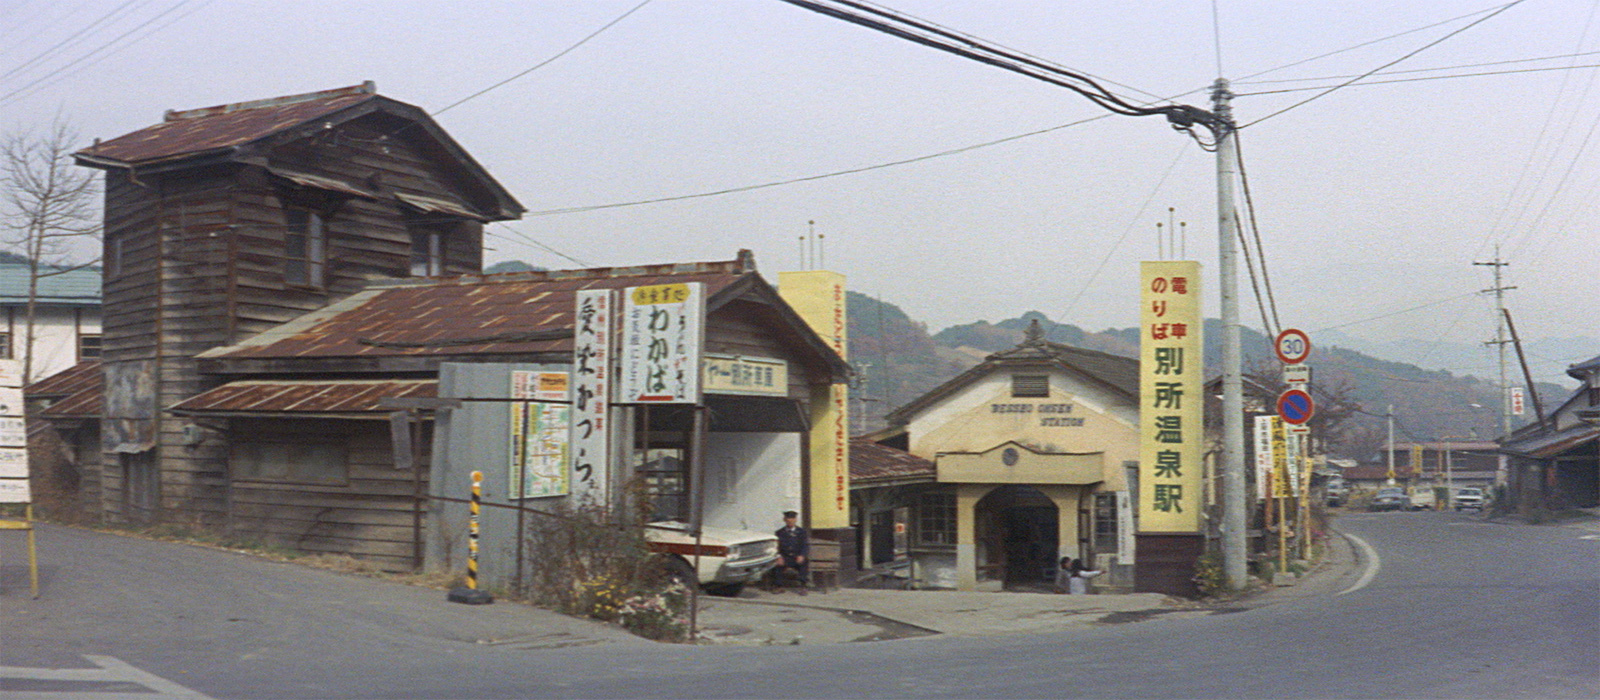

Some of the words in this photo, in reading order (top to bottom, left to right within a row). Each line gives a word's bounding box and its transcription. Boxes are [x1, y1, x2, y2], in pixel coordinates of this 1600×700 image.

[1151, 277, 1169, 340] のりば
[1171, 277, 1187, 339] 電車
[647, 305, 669, 392] わかば
[701, 362, 774, 387] ヤー別所車庫
[1282, 339, 1303, 354] 30
[1153, 347, 1184, 513] 別所温泉駅
